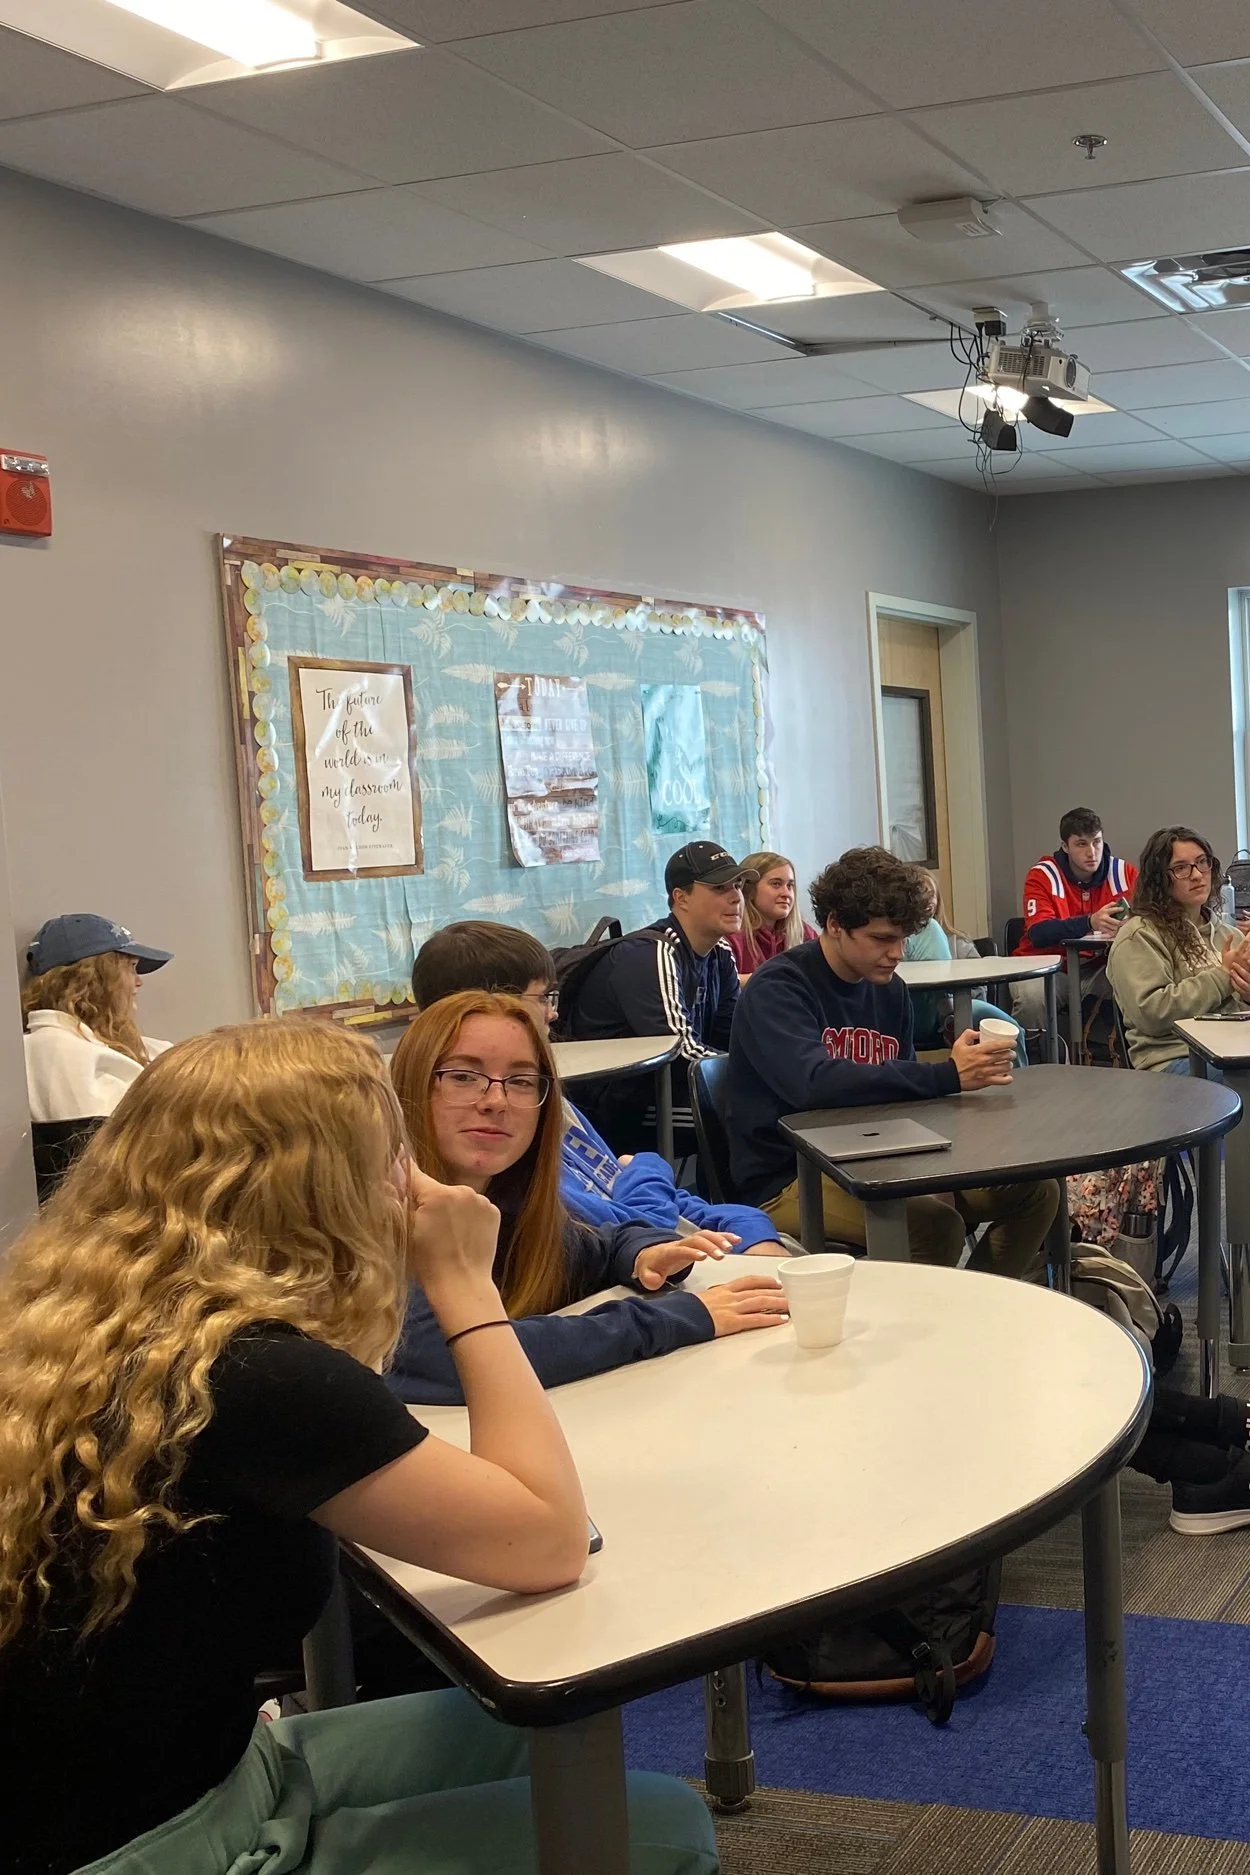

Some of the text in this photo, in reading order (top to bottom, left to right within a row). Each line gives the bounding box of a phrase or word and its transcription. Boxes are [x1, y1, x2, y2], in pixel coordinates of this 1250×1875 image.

[346, 690, 383, 716] future
[335, 719, 352, 746] of
[324, 747, 360, 769] world
[321, 778, 402, 809] my classroom
